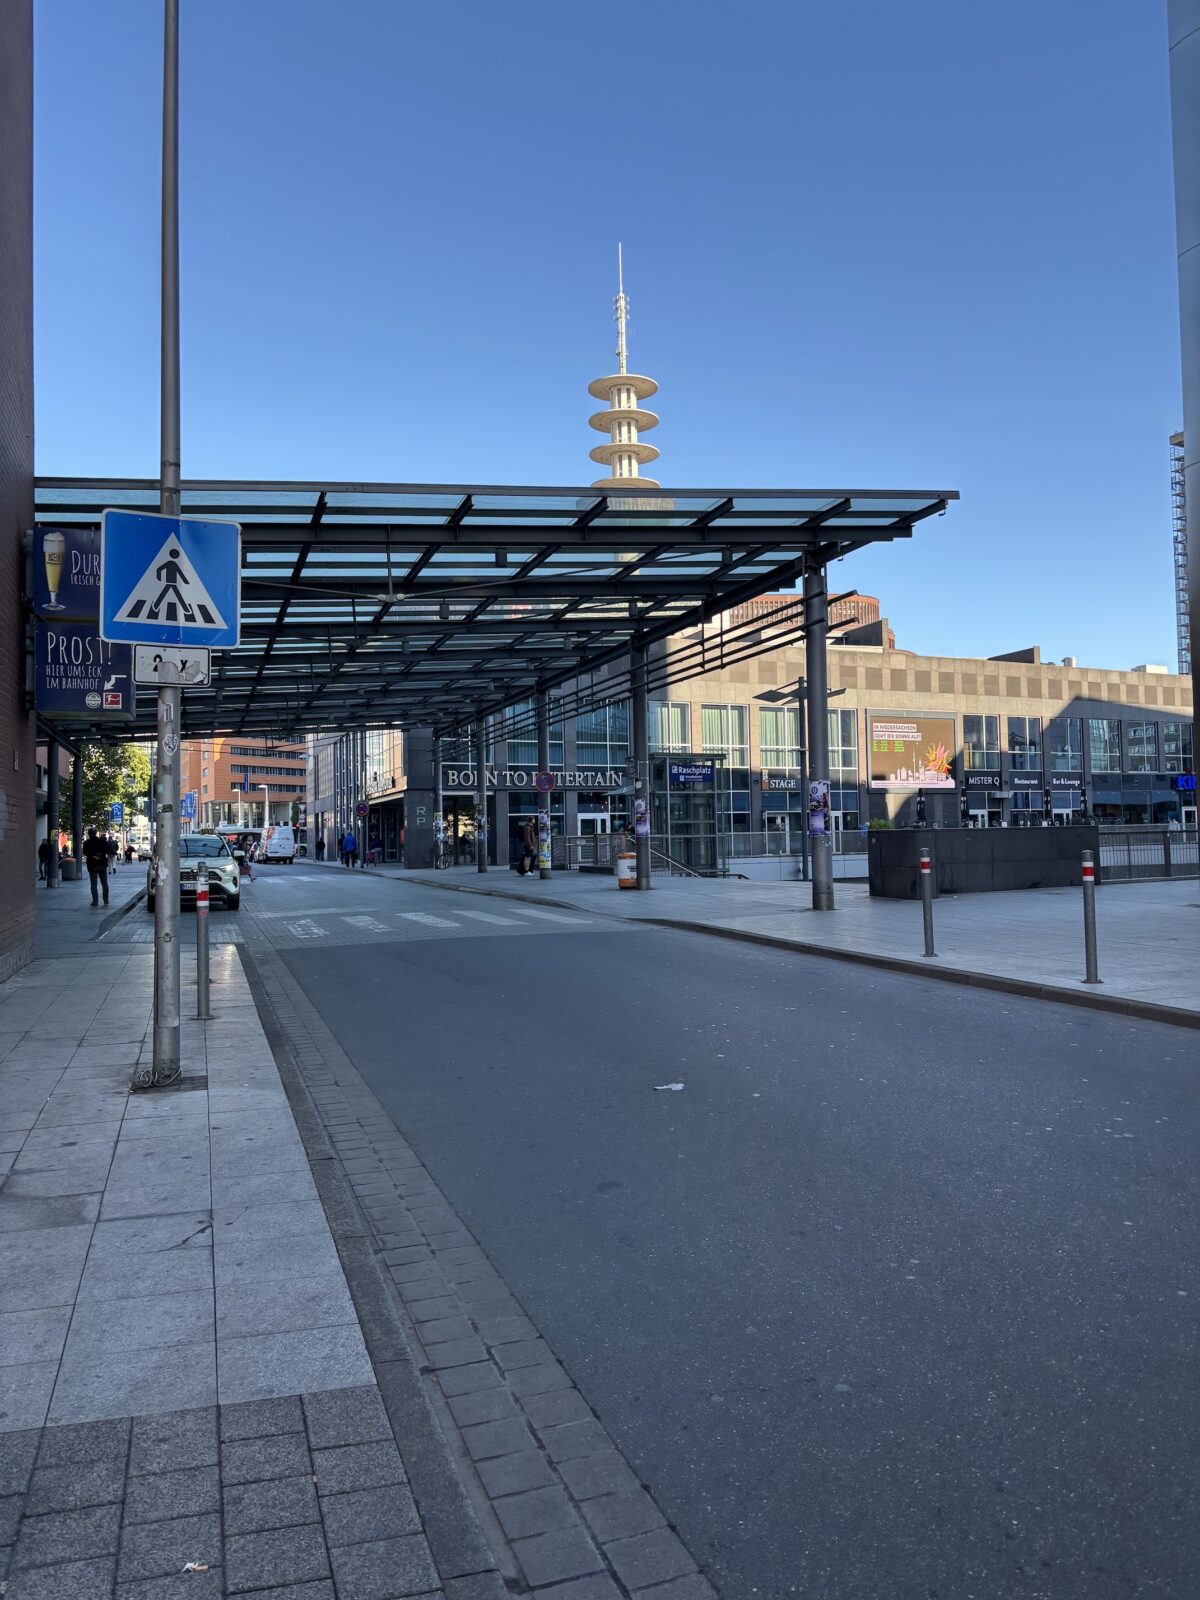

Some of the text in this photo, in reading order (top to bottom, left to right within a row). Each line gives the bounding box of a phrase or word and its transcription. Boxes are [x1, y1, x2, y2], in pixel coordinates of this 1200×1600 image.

[71, 573, 94, 586] FRISCH
[46, 664, 102, 677] HIER UMS ECK
[46, 677, 99, 690] IM BAHNHOF
[678, 766, 712, 776] Raschplatz
[503, 771, 528, 786] TO
[770, 779, 796, 788] STAGE
[968, 776, 1000, 786] MISTER Q
[1014, 777, 1038, 785] Restaurant
